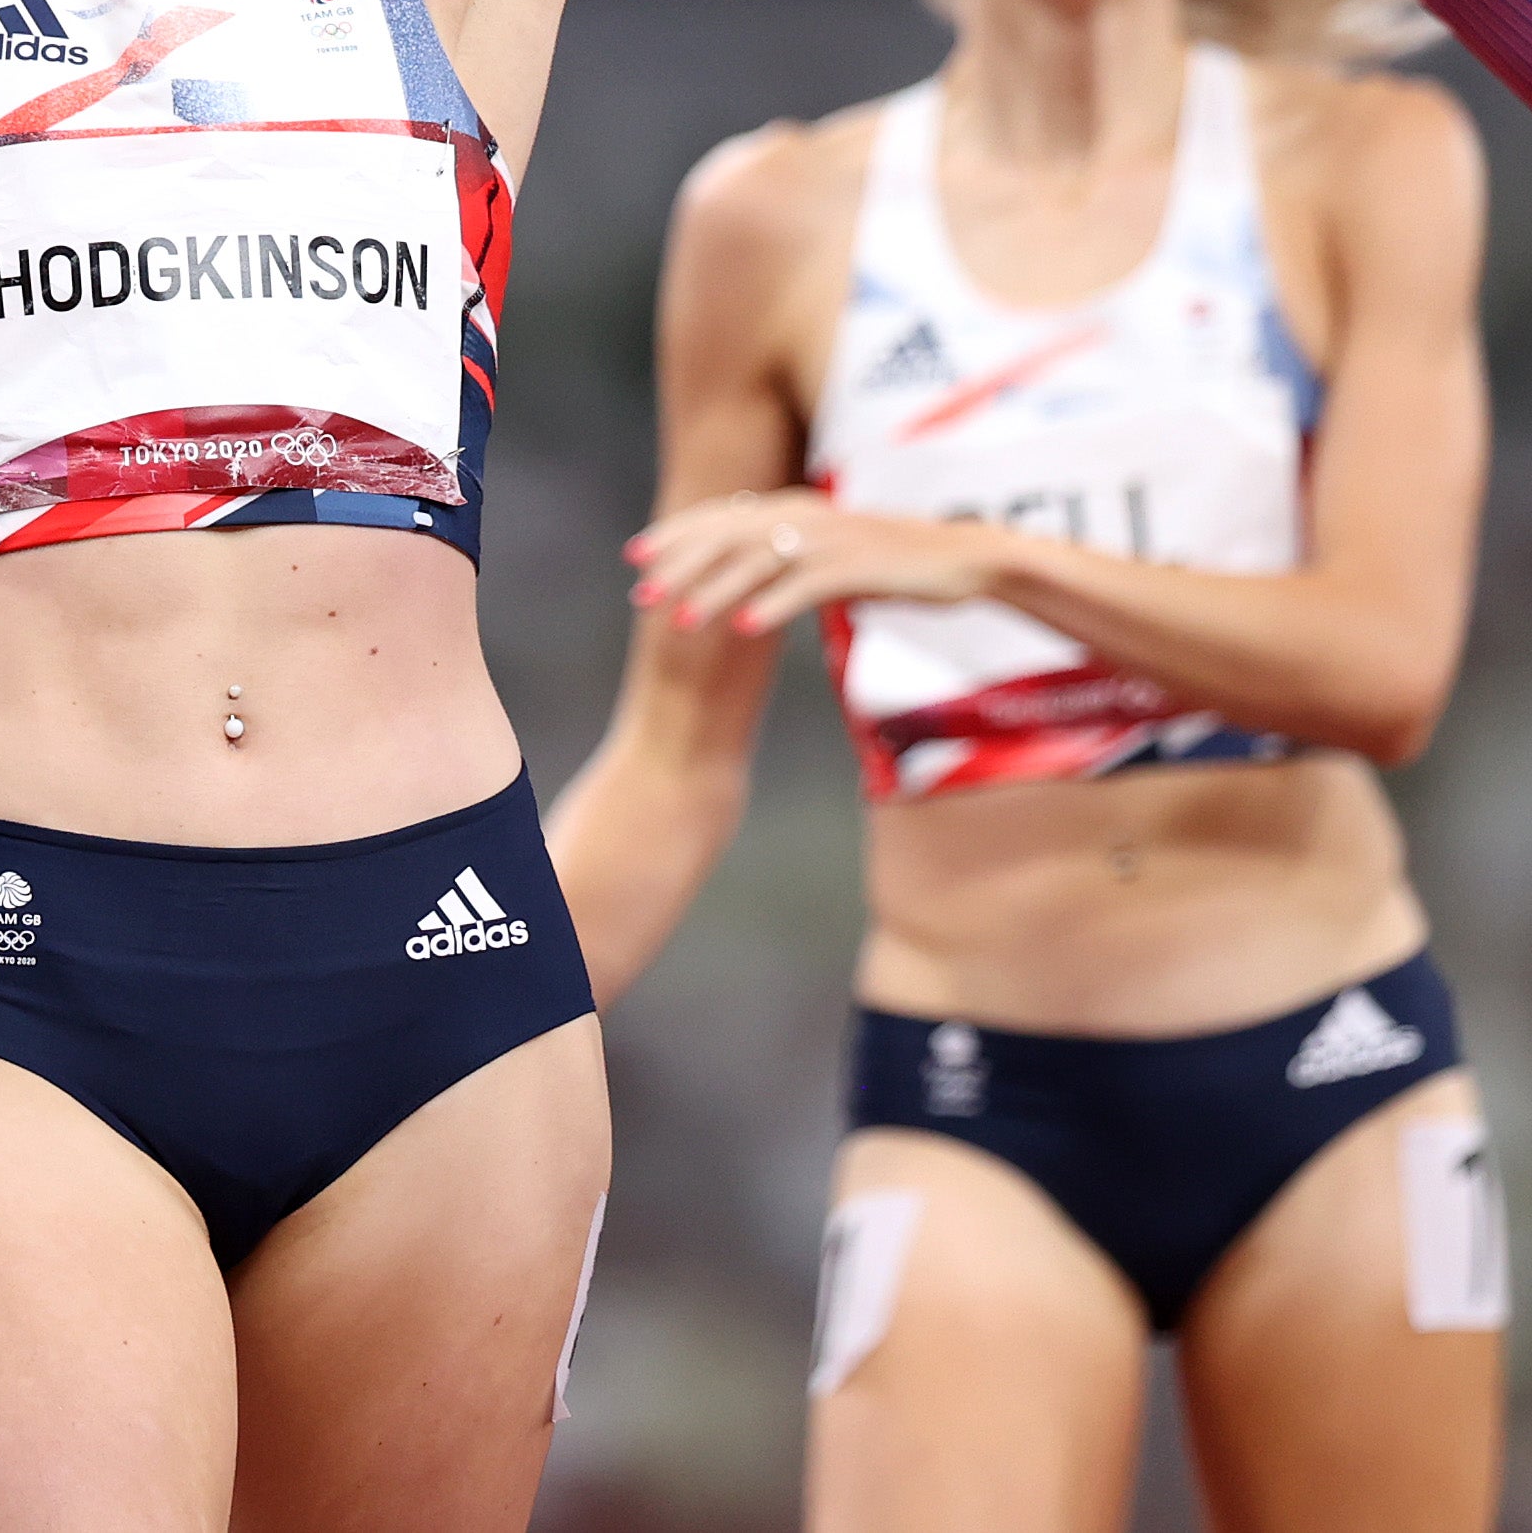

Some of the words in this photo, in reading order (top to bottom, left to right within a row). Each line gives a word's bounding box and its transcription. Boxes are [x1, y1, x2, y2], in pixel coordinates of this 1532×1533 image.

[300, 9, 333, 22] TEAM
[336, 6, 354, 17] GB
[119, 441, 200, 467] TOKYO
[205, 439, 263, 460] 2020
[21, 913, 42, 926] GB
[405, 919, 529, 960] adidas
[16, 956, 36, 965] 2020
